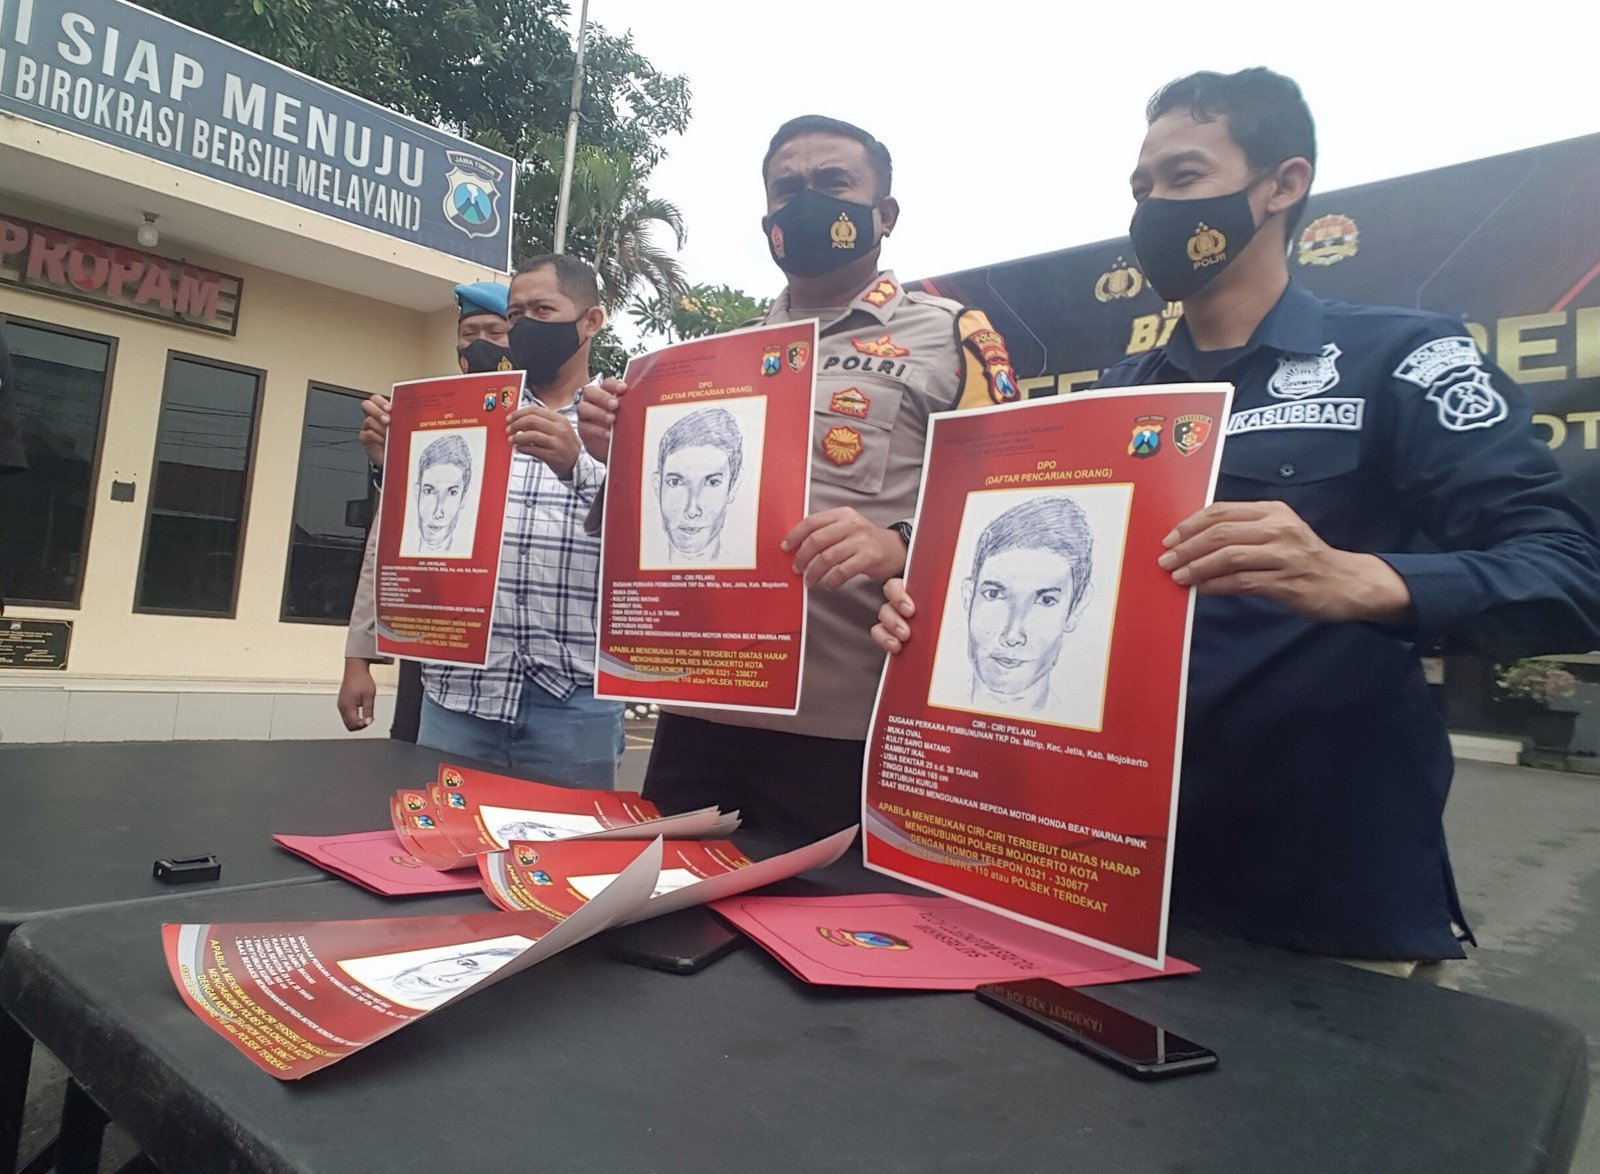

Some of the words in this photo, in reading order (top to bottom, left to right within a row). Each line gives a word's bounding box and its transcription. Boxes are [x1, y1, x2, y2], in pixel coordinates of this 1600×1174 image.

[57, 12, 204, 101] SIAP
[223, 71, 425, 188] MENUJU
[15, 55, 184, 151] BIROKRASI
[192, 117, 289, 188] BERSIH
[297, 155, 422, 233] MELAYANI)
[455, 157, 474, 167] JAWA
[475, 160, 496, 176] TIMUR
[823, 355, 907, 378] POLRI
[699, 381, 713, 389] DPO
[1233, 403, 1356, 430] KASUBBAG
[1037, 460, 1057, 470] DPO
[985, 473, 1020, 486] (DAFTAR
[1021, 470, 1073, 482] PENCARIAN
[1074, 468, 1112, 480] ORANG)
[702, 659, 744, 668] MOJOKERTO
[745, 661, 764, 669] KOTA
[703, 650, 738, 658] TERSEBUT
[739, 651, 763, 659] DIATAS
[764, 652, 788, 660] HARAP
[887, 726, 905, 735] MUKA
[905, 729, 922, 739] OVAL
[972, 719, 986, 729] CIRI
[991, 722, 1006, 732] CIRI
[1006, 725, 1037, 738] PELAKU
[884, 744, 911, 754] RAMBUT
[911, 748, 926, 758] IKAL
[886, 735, 904, 744] KULIT
[904, 739, 923, 748] SAWO
[924, 742, 951, 754] MATANG
[888, 715, 915, 727] DUGAAN
[914, 719, 946, 732] PERKARA
[946, 725, 995, 740] PEMBUNUHAN
[995, 732, 1009, 743] TKP
[1087, 749, 1105, 760] Kab.
[1107, 753, 1149, 768] Mojokerto
[882, 761, 903, 772] TINGGI
[904, 766, 926, 777] BADAN
[939, 774, 949, 782] cm
[883, 753, 898, 761] USIA
[898, 755, 925, 766] SEKITAR
[955, 768, 979, 779] TAHUN
[881, 770, 915, 783] BERTUBUH
[915, 778, 938, 789] KURUS
[880, 779, 896, 789] SAAT
[897, 784, 925, 796] BERAKSI
[926, 791, 979, 809] MENGGUNAKAN
[979, 802, 1008, 816] SEPEDA
[1009, 810, 1037, 823] MOTOR
[1038, 816, 1067, 830] HONDA
[1068, 822, 1090, 835] BEAT
[1091, 828, 1125, 844] WARNA
[1125, 836, 1148, 849] PINK
[878, 802, 911, 817] APABILA
[912, 811, 965, 832] MENEMUKAN
[967, 825, 1006, 842] CIRI-CIRI
[1008, 835, 1059, 856] TERSEBUT
[1061, 849, 1098, 867] DIATAS
[1100, 859, 1141, 878] HARAP
[905, 820, 966, 845] MENGHUBUNGI
[967, 837, 1004, 855] POLRES
[1005, 848, 1067, 873] MOJOKERTO
[1070, 865, 1099, 882] KOTA
[910, 834, 945, 851] DENGAN
[946, 845, 979, 861] NOMOR
[980, 857, 1023, 874] TELEPON
[1025, 868, 1046, 881] 0321
[1055, 875, 1090, 893] 330677
[974, 866, 989, 877] 110
[990, 873, 1010, 884] atau
[1011, 876, 1051, 896] POLSEK
[1052, 888, 1109, 913] TERDEKAT
